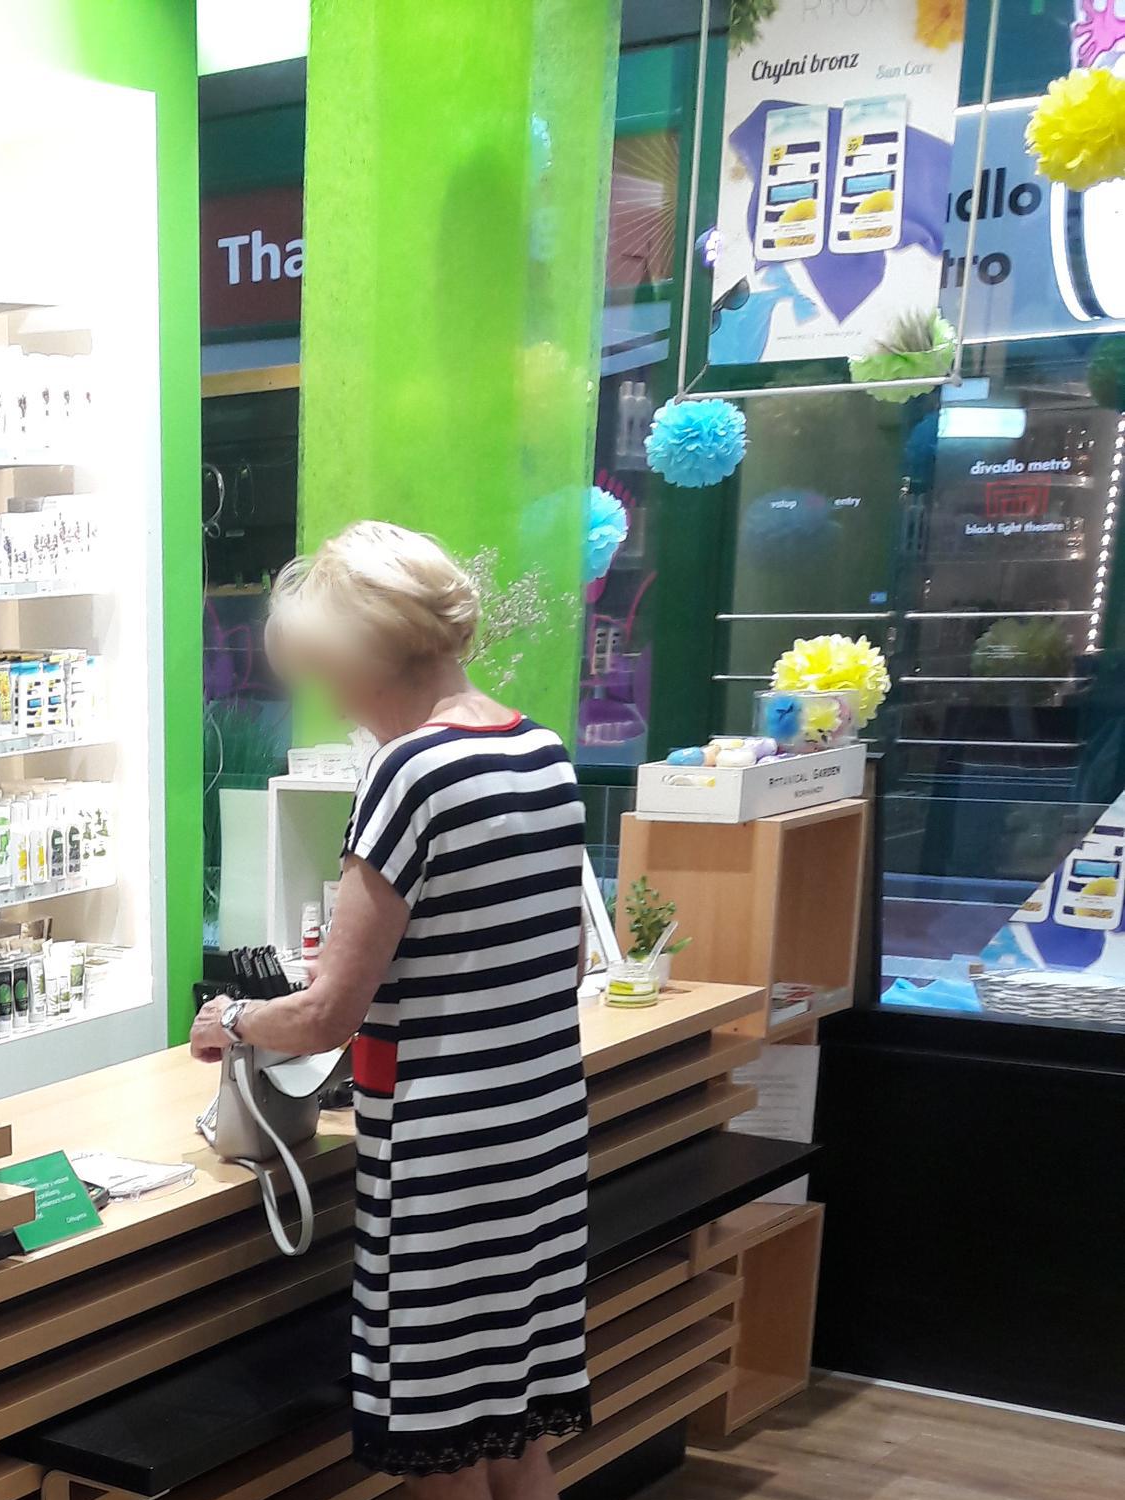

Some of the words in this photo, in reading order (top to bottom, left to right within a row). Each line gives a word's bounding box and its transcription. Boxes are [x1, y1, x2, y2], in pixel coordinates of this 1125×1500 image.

[811, 53, 860, 73] bronz
[940, 249, 1011, 288] tro
[970, 458, 1025, 475] divadlo
[834, 496, 861, 508] entry
[965, 523, 995, 535] black
[997, 522, 1022, 536] light
[1024, 521, 1064, 532] theatre
